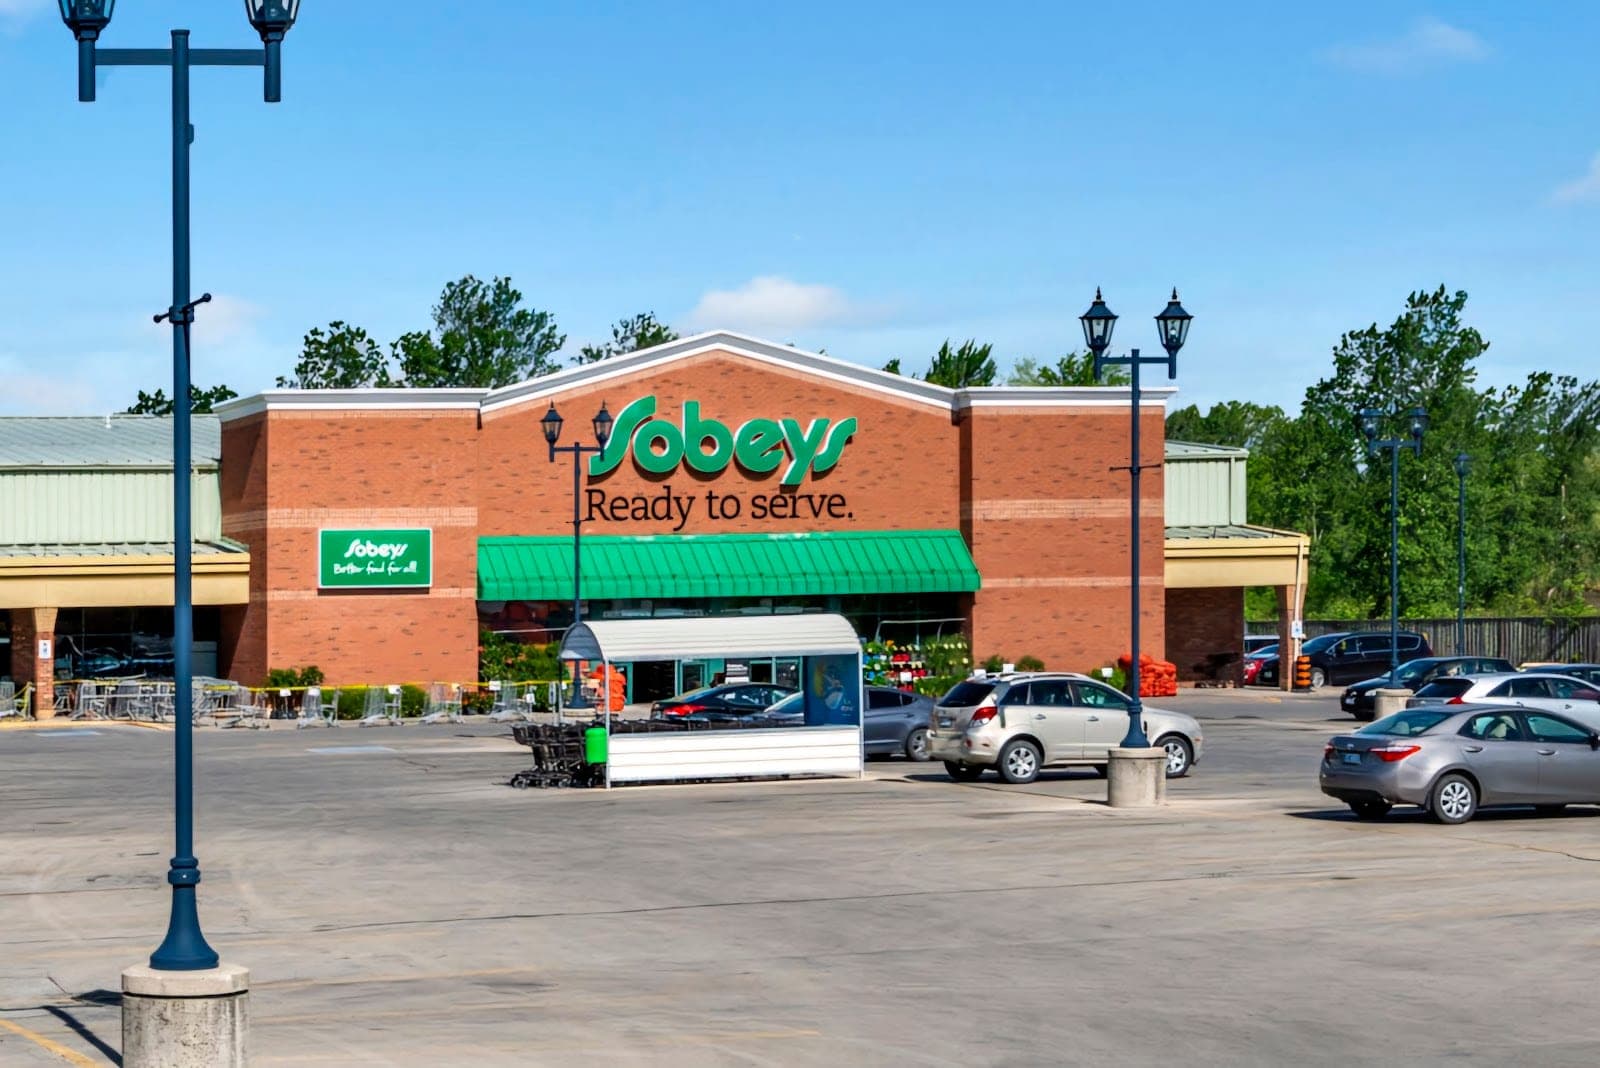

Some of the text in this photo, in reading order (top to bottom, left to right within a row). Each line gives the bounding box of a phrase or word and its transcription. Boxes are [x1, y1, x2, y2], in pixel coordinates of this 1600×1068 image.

[588, 394, 858, 485] Sobeys
[585, 485, 854, 532] Ready to serve.
[344, 538, 409, 561] Sobeys
